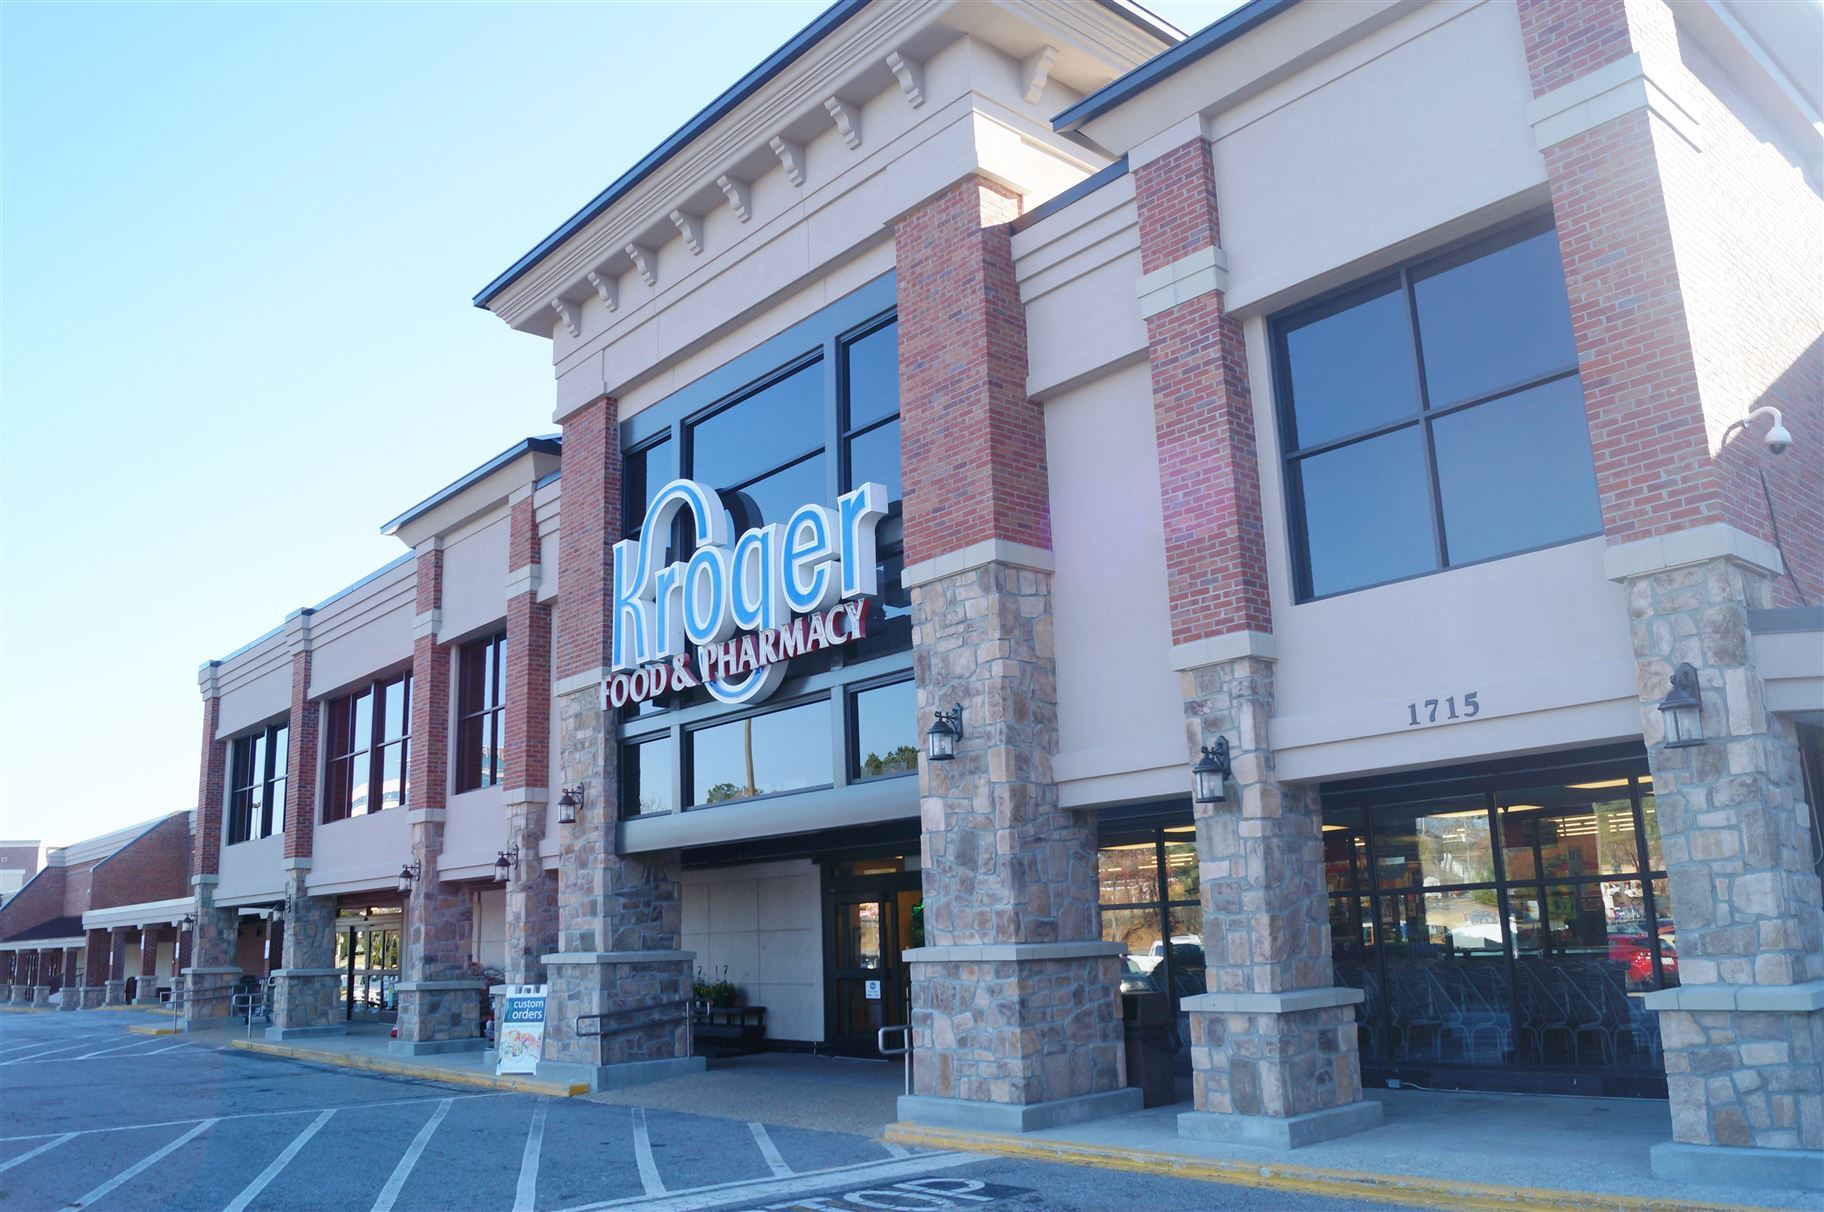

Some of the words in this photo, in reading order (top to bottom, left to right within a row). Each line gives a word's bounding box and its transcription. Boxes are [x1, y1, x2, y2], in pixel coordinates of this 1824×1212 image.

[612, 478, 888, 704] Kroger
[601, 662, 672, 711] FOOD
[671, 652, 700, 692] &
[700, 597, 869, 683] PHARMACY
[1407, 691, 1480, 726] 1715
[512, 1009, 543, 1019] orders
[513, 1000, 544, 1009] custom
